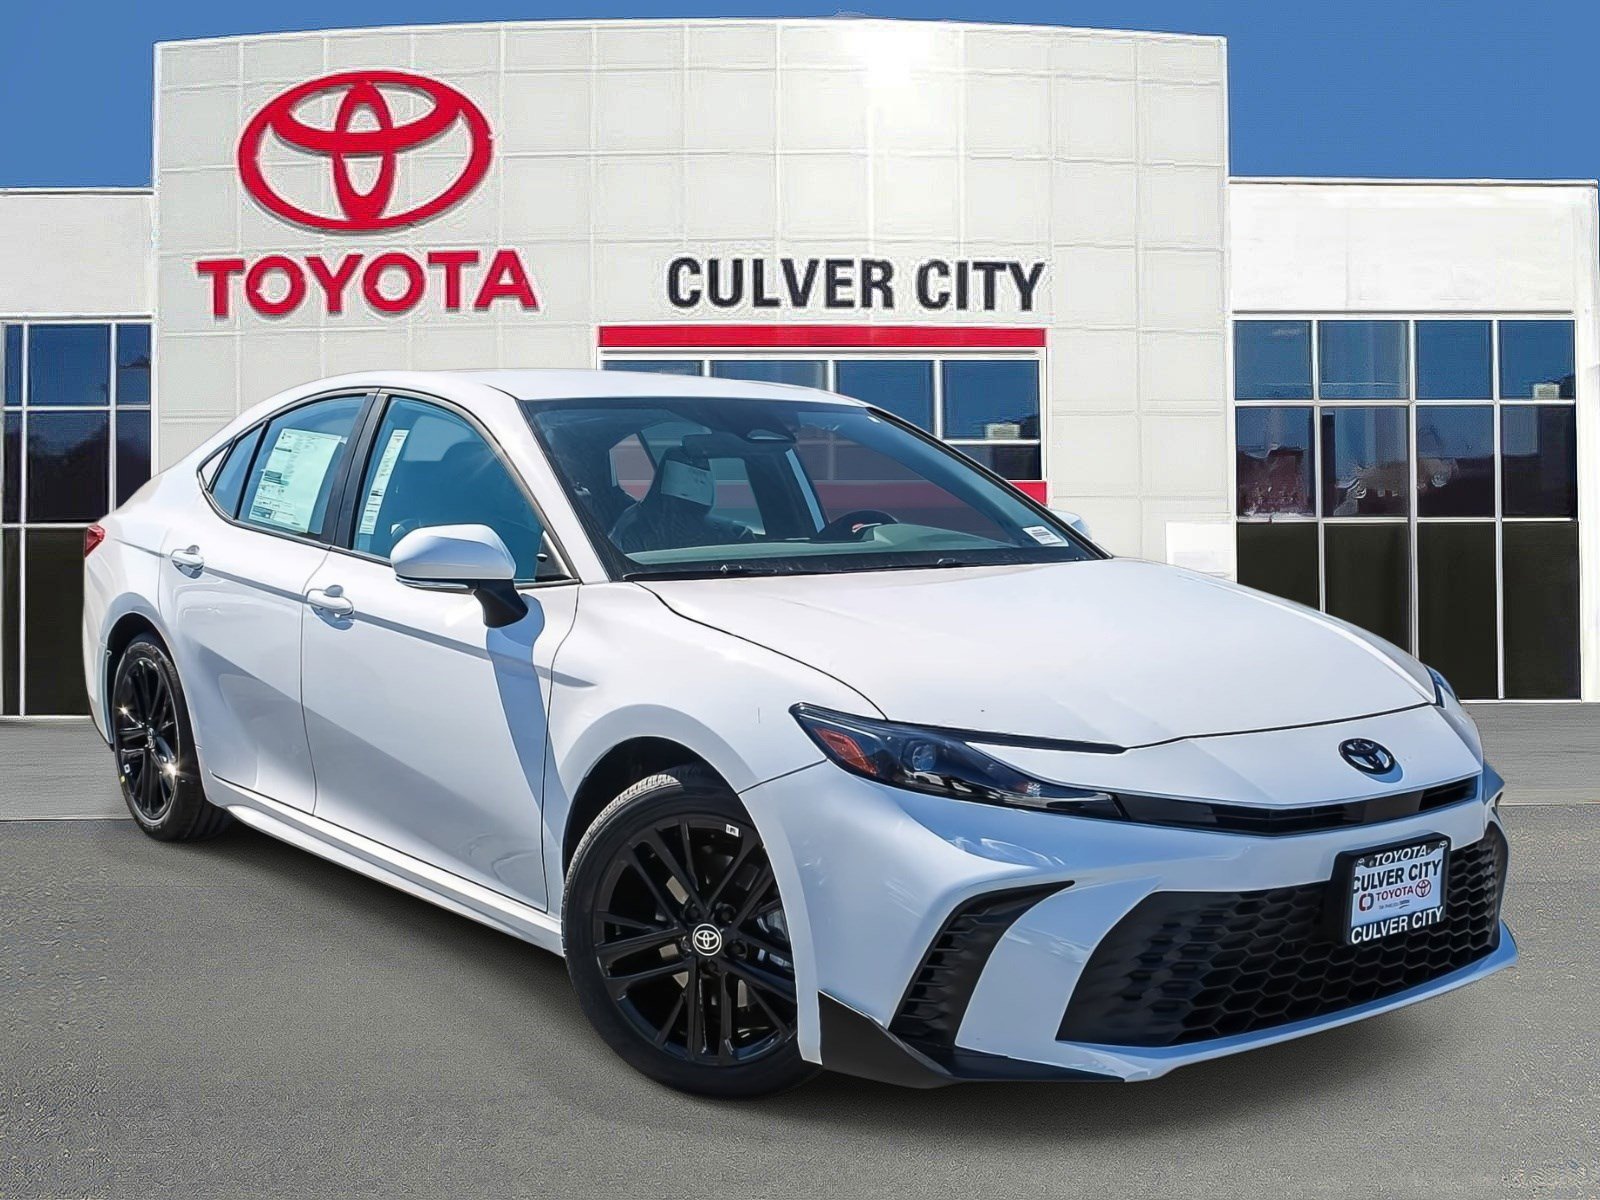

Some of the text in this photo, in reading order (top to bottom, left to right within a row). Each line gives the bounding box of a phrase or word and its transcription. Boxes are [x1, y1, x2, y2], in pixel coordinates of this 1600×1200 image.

[197, 249, 539, 318] TOYOTA
[667, 258, 1046, 311] CULVER CITY
[1374, 845, 1427, 866] TOYOTA
[1353, 859, 1442, 894] CULVER CITY
[1376, 886, 1414, 902] TOYOTA
[1351, 906, 1444, 944] CULVER CITY
